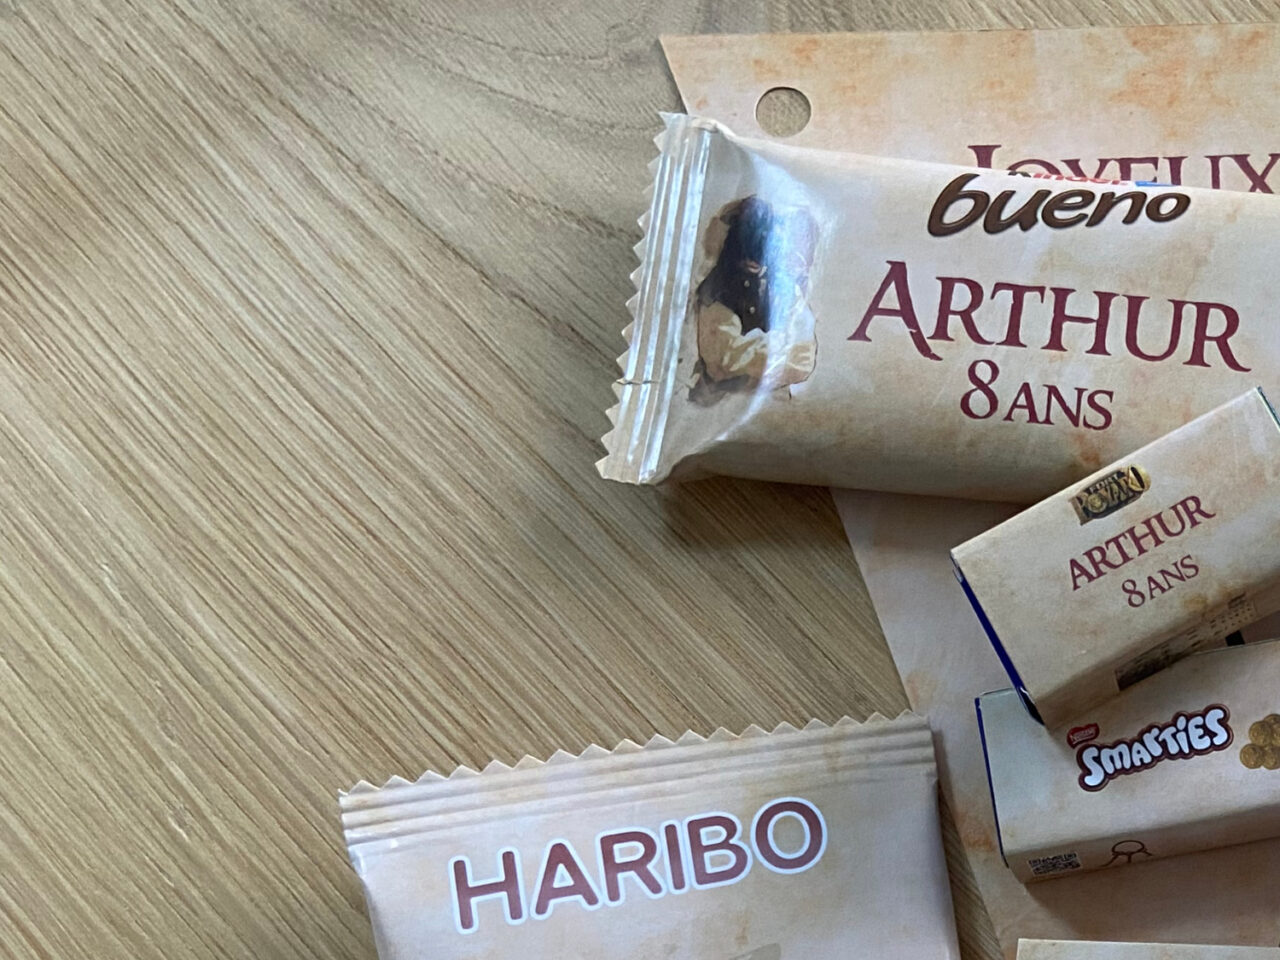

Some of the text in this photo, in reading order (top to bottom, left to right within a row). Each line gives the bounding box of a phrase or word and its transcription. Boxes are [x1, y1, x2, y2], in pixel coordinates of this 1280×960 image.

[927, 172, 1191, 238] bueno
[847, 260, 1252, 373] ARTHUR
[1068, 495, 1217, 592] ARTHUR
[452, 799, 825, 931] HARIBO
